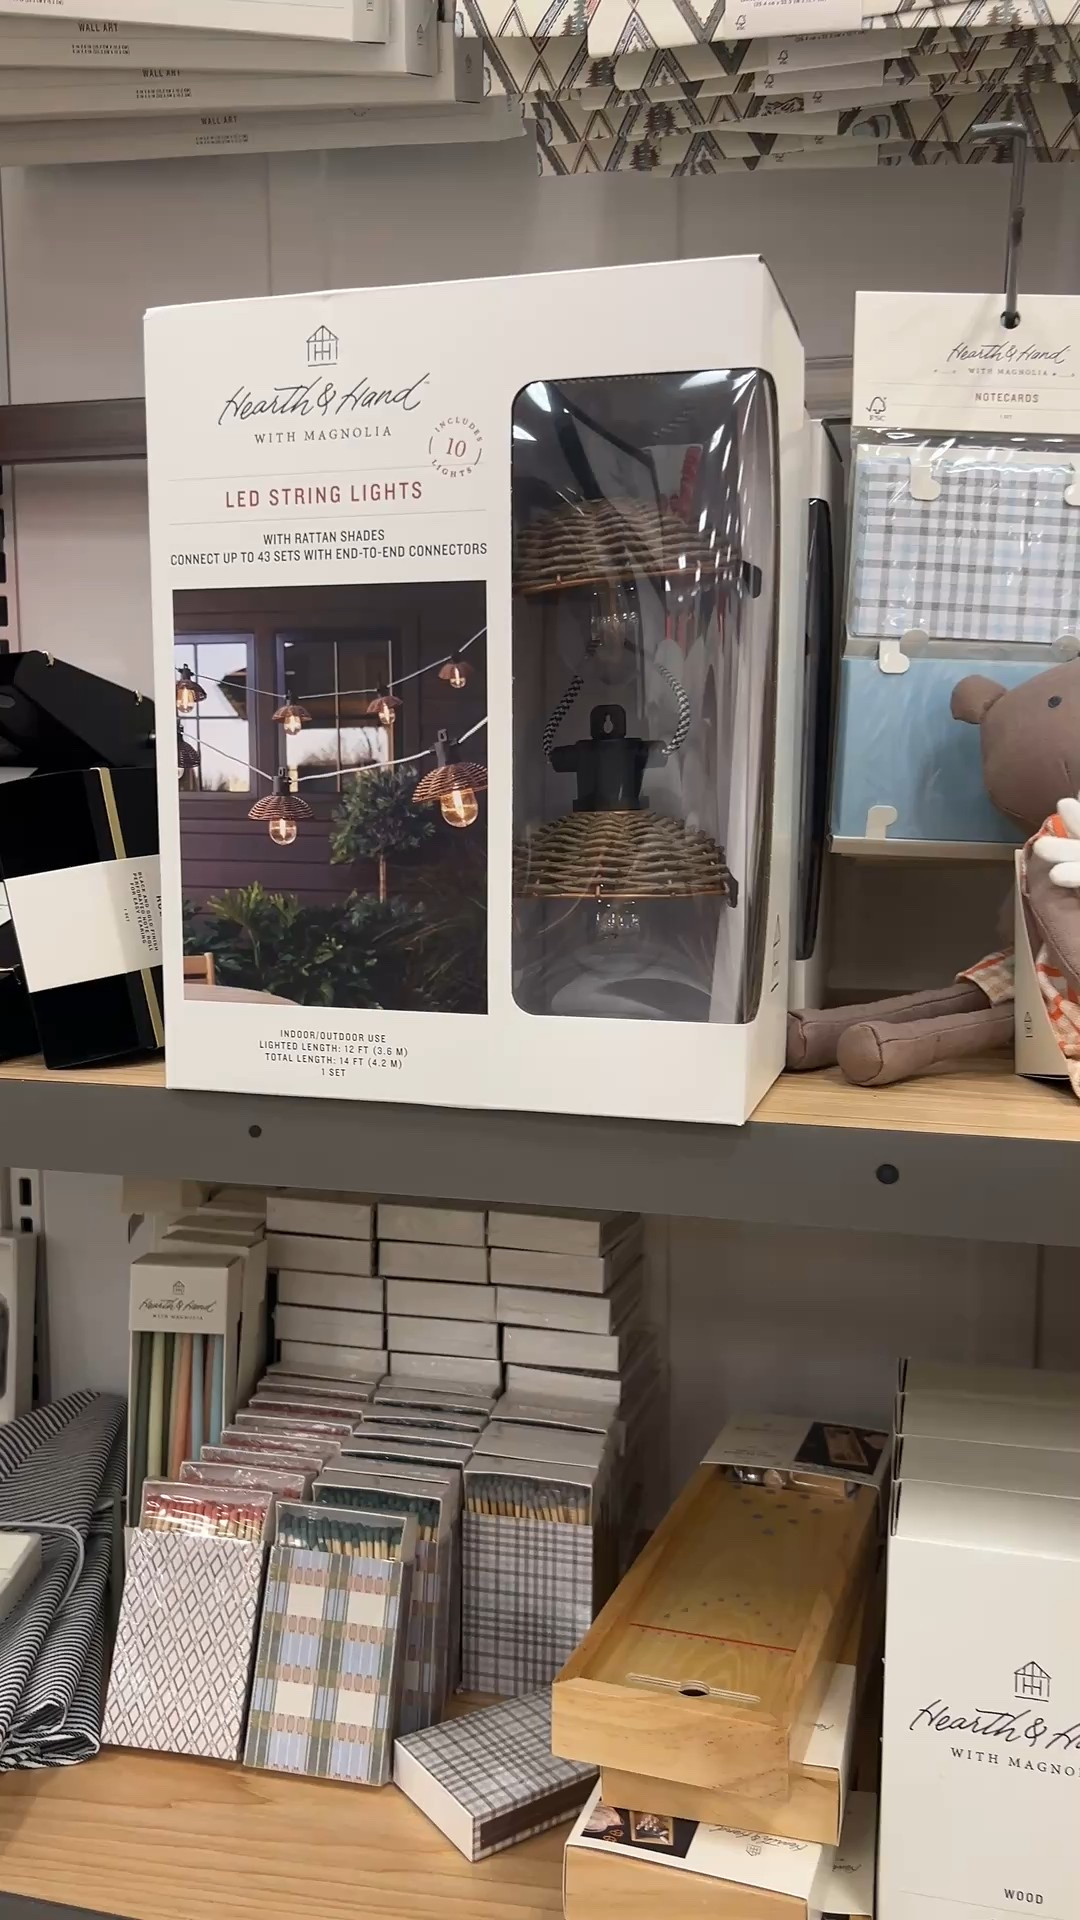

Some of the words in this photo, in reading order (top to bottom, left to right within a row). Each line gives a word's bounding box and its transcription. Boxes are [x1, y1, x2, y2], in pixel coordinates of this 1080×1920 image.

[79, 23, 100, 32] WALL
[103, 22, 118, 32] ART
[142, 69, 163, 77] WALL
[201, 117, 221, 125] WALL
[947, 341, 1010, 362] Hearth
[1005, 344, 1018, 362] &
[1016, 343, 1071, 364] Hand
[997, 368, 1048, 376] MAGNOLIA
[218, 376, 322, 425] Hearth
[317, 382, 336, 416] &
[335, 372, 430, 416] Hand
[975, 392, 1039, 403] NOTECARDS
[254, 432, 296, 444] WITH
[304, 426, 392, 442] MAGNOLIA
[435, 416, 483, 442] INCLUDES
[446, 437, 467, 457] 10
[432, 459, 472, 477] LIGHTS
[225, 489, 260, 508] LED
[269, 485, 341, 507] STRING
[350, 481, 423, 502] LIGHTS
[263, 533, 291, 545] WITH
[295, 531, 337, 544] RATTAN
[340, 529, 385, 543] SHADES
[170, 552, 219, 566] CONNECT
[223, 552, 237, 564] UP
[240, 551, 255, 563] TO
[257, 550, 271, 563] 43
[273, 549, 300, 562] SETS
[304, 548, 333, 561] WITH
[336, 545, 405, 560] END-TO-END
[409, 542, 487, 557] CONNECTORS
[280, 1029, 364, 1042] INDOOR/OUTDOOR
[367, 1034, 386, 1043] USE
[259, 1040, 298, 1051] LIGHTED
[301, 1042, 341, 1053] LENGTH:
[344, 1045, 354, 1054] 12
[358, 1045, 369, 1055] FT
[372, 1046, 392, 1057] (3.6
[395, 1047, 408, 1058] M)
[265, 1052, 293, 1062] TOTAL
[296, 1054, 336, 1065] LENGTH:
[339, 1057, 349, 1066] 14
[353, 1057, 364, 1066] FT
[368, 1057, 387, 1068] (4.2
[390, 1059, 403, 1069] M)
[329, 1068, 346, 1077] SET
[909, 1699, 1031, 1742] Hearth
[1024, 1717, 1047, 1747] &
[950, 1747, 999, 1764] WITH
[1008, 1756, 1080, 1778] MAGNO
[1004, 1888, 1044, 1904] WOOD
